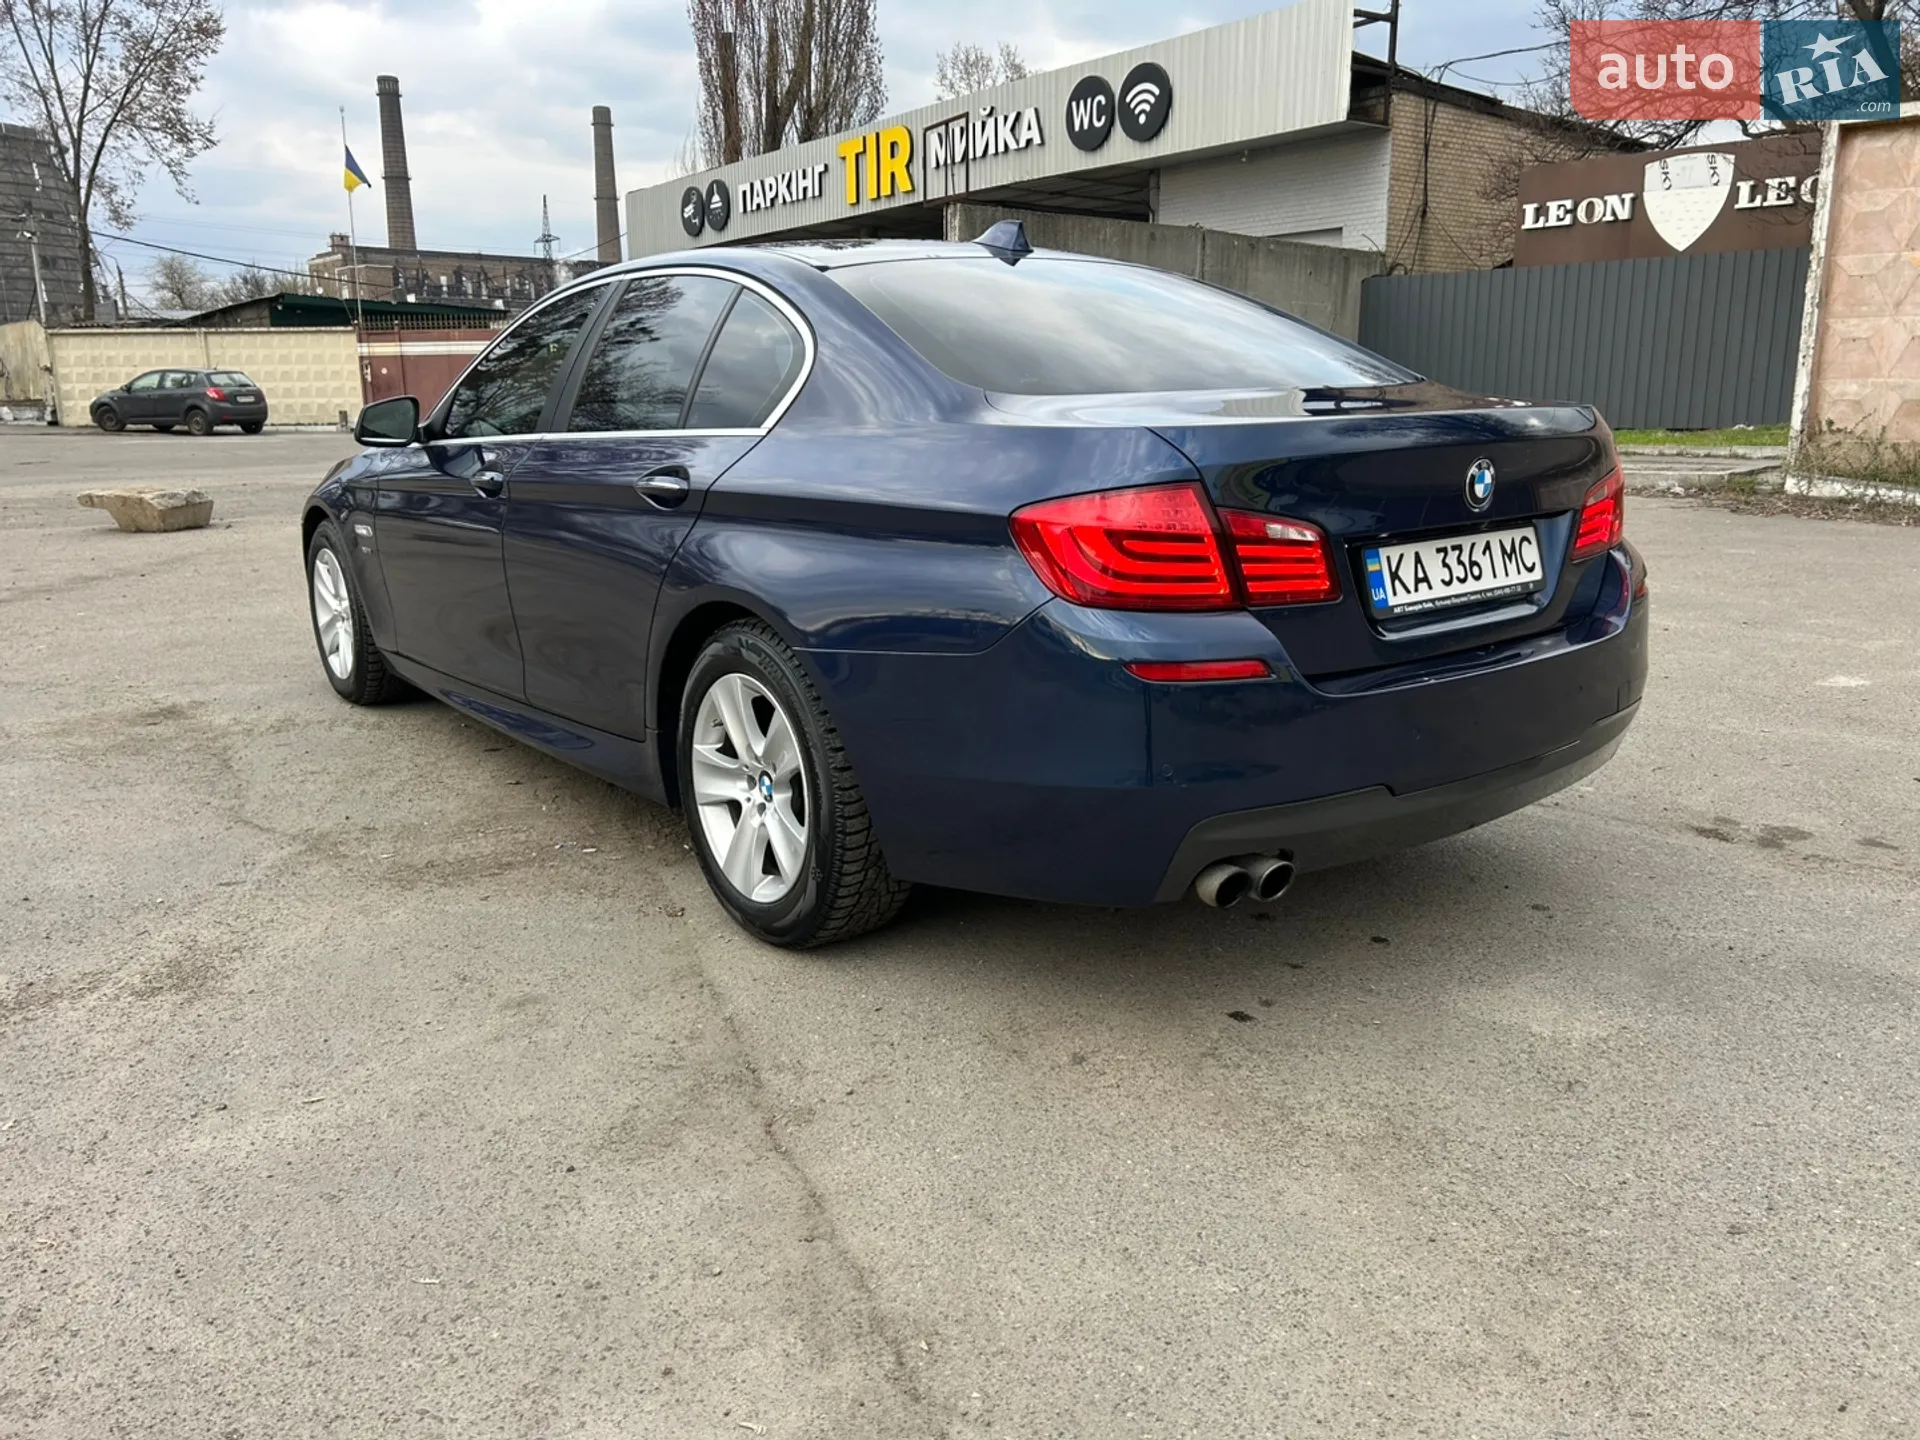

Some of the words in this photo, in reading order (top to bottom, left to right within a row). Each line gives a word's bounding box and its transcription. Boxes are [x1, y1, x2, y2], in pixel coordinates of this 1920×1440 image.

[1071, 93, 1107, 131] WC
[931, 107, 1043, 169] МИЙКА
[738, 163, 827, 214] ПАРКІНГ
[838, 125, 914, 204] TIR
[1521, 193, 1635, 230] LEON
[1386, 550, 1433, 597] KA
[1435, 539, 1497, 587] 3361
[1499, 535, 1536, 578] MC
[1371, 588, 1387, 602] UA
